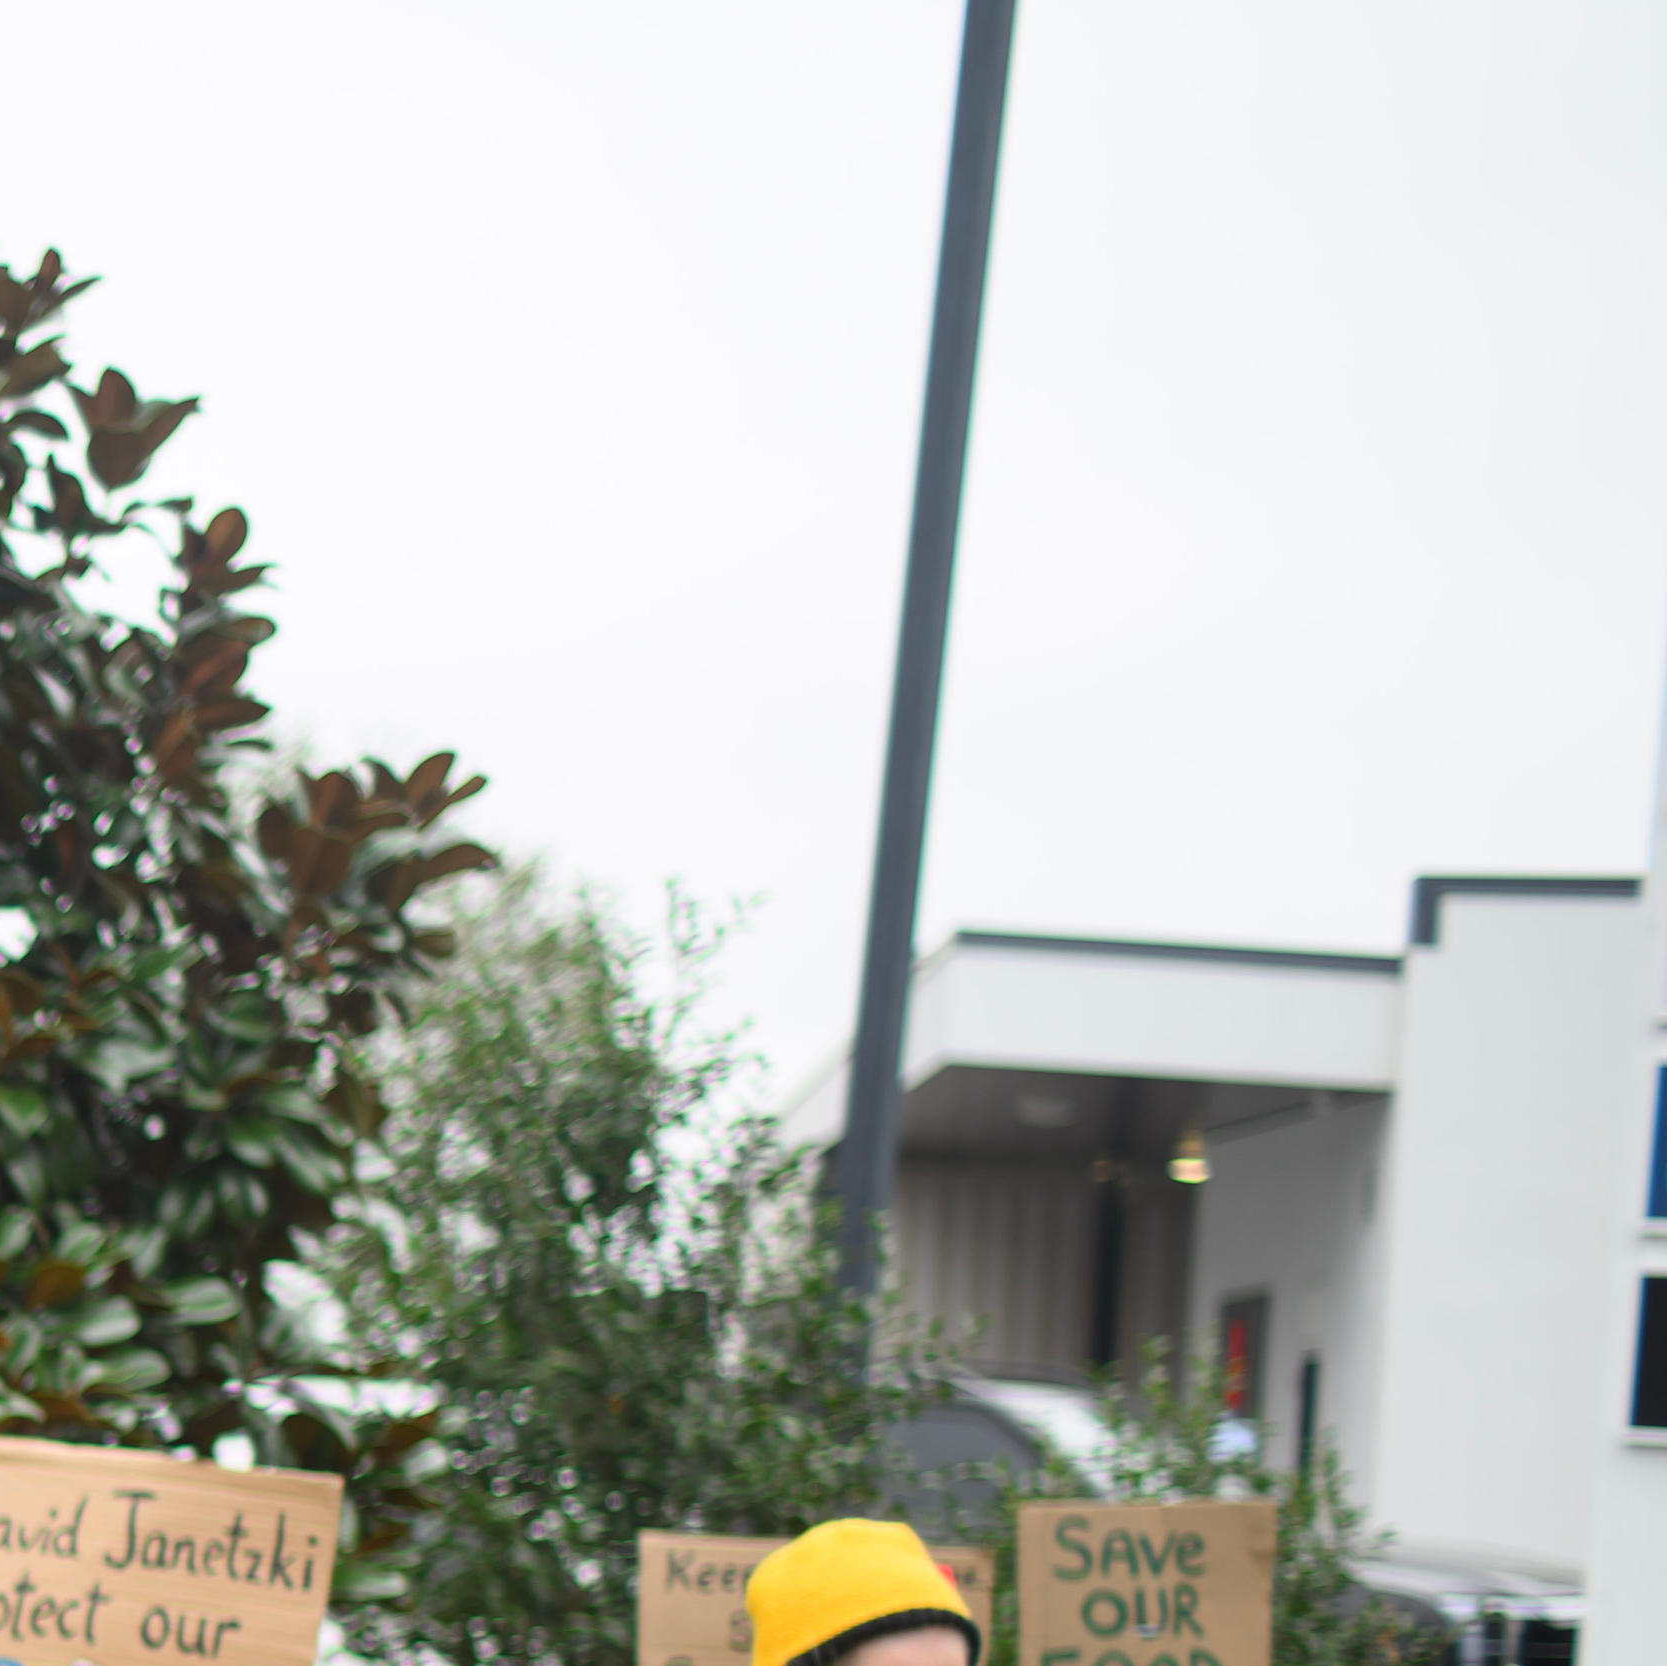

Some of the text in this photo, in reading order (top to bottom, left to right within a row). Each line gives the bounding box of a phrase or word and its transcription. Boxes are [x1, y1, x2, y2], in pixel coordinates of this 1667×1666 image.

[104, 1489, 320, 1592] Janetzki
[140, 1606, 242, 1659] our
[1081, 1583, 1204, 1639] OUR
